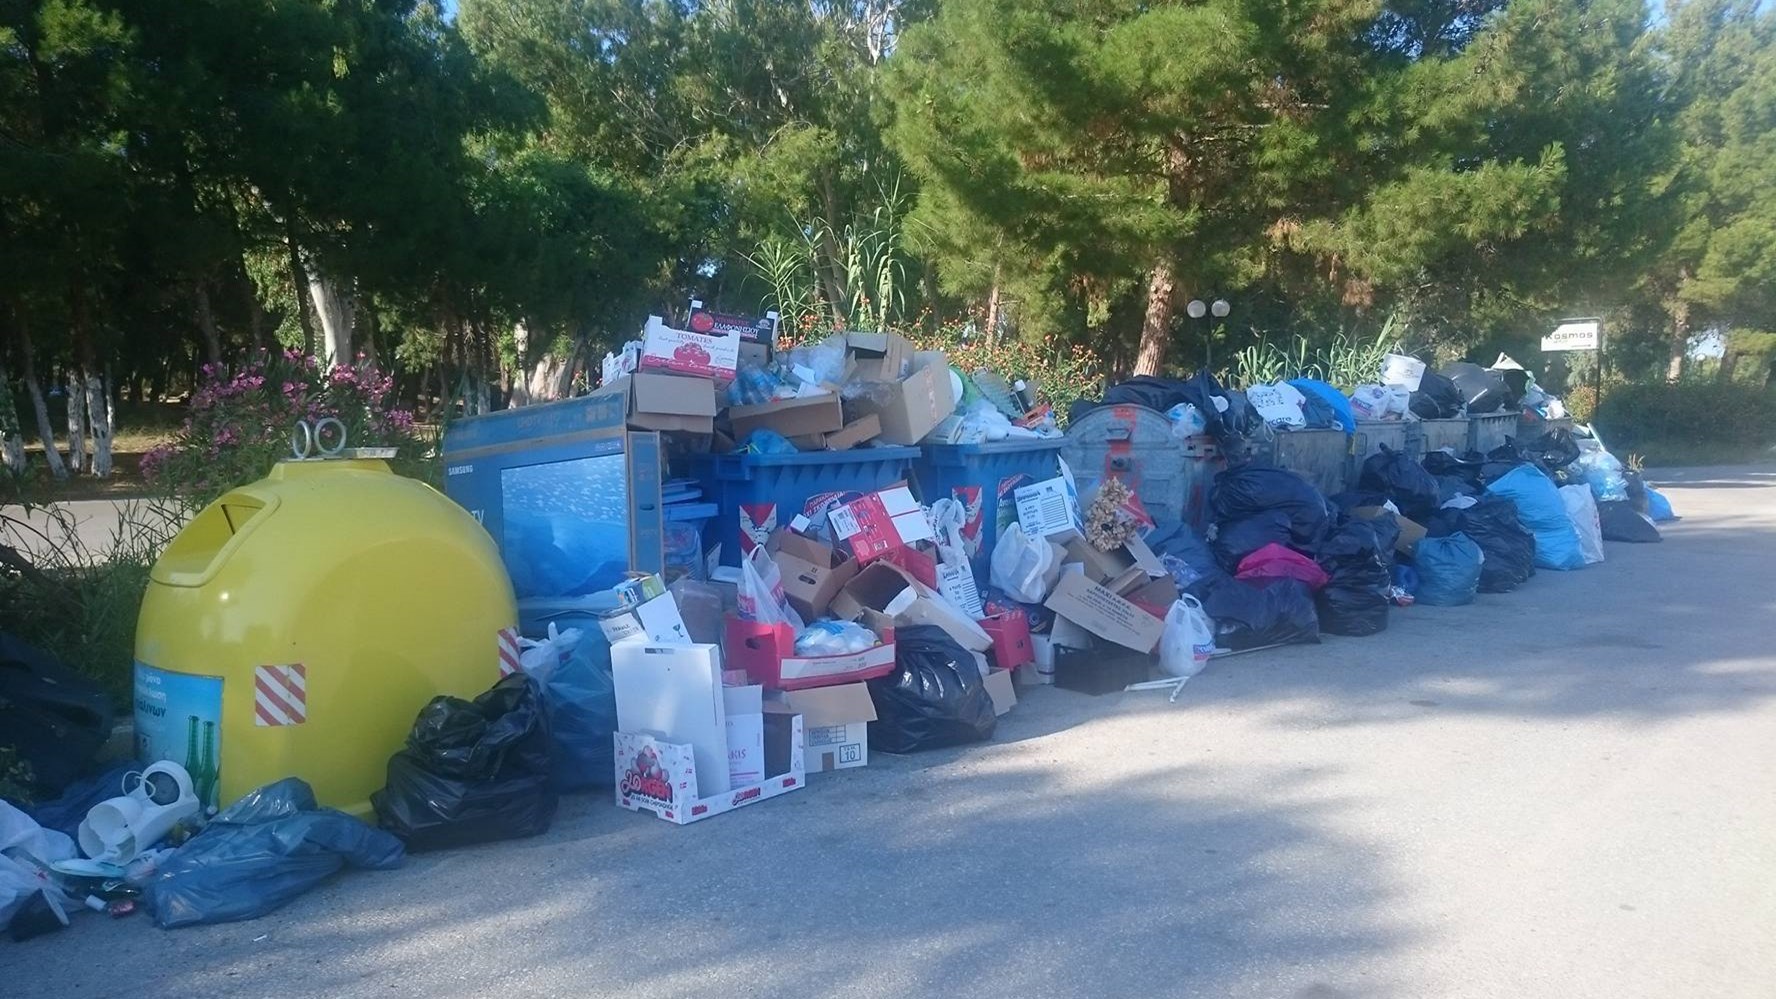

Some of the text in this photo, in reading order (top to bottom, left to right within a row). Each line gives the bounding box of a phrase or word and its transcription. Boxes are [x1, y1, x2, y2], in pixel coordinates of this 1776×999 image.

[676, 332, 713, 345] TOMATES
[448, 465, 473, 476] SAMSUNG
[845, 750, 856, 760] 10
